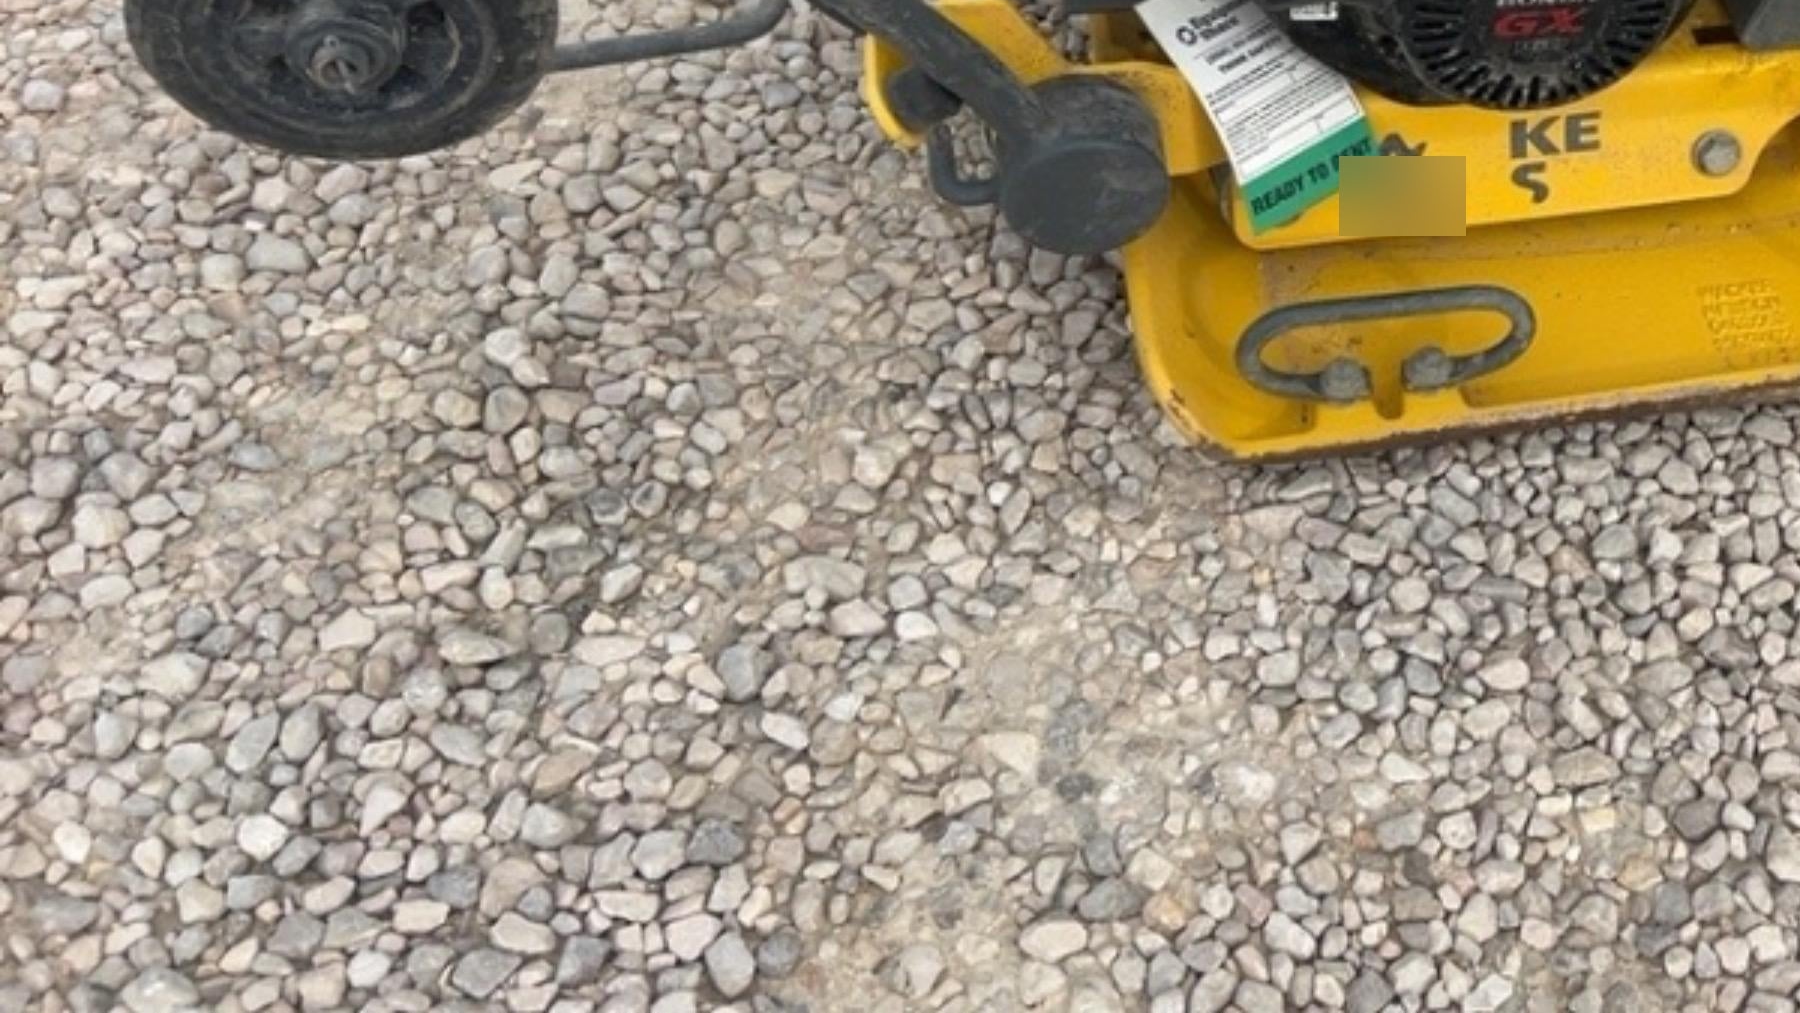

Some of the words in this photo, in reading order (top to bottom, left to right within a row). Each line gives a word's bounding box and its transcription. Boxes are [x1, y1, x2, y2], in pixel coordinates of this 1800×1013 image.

[1493, 9, 1585, 39] GX
[1511, 110, 1601, 159] KE
[1250, 174, 1306, 215] READY
[1307, 162, 1331, 185] TO
